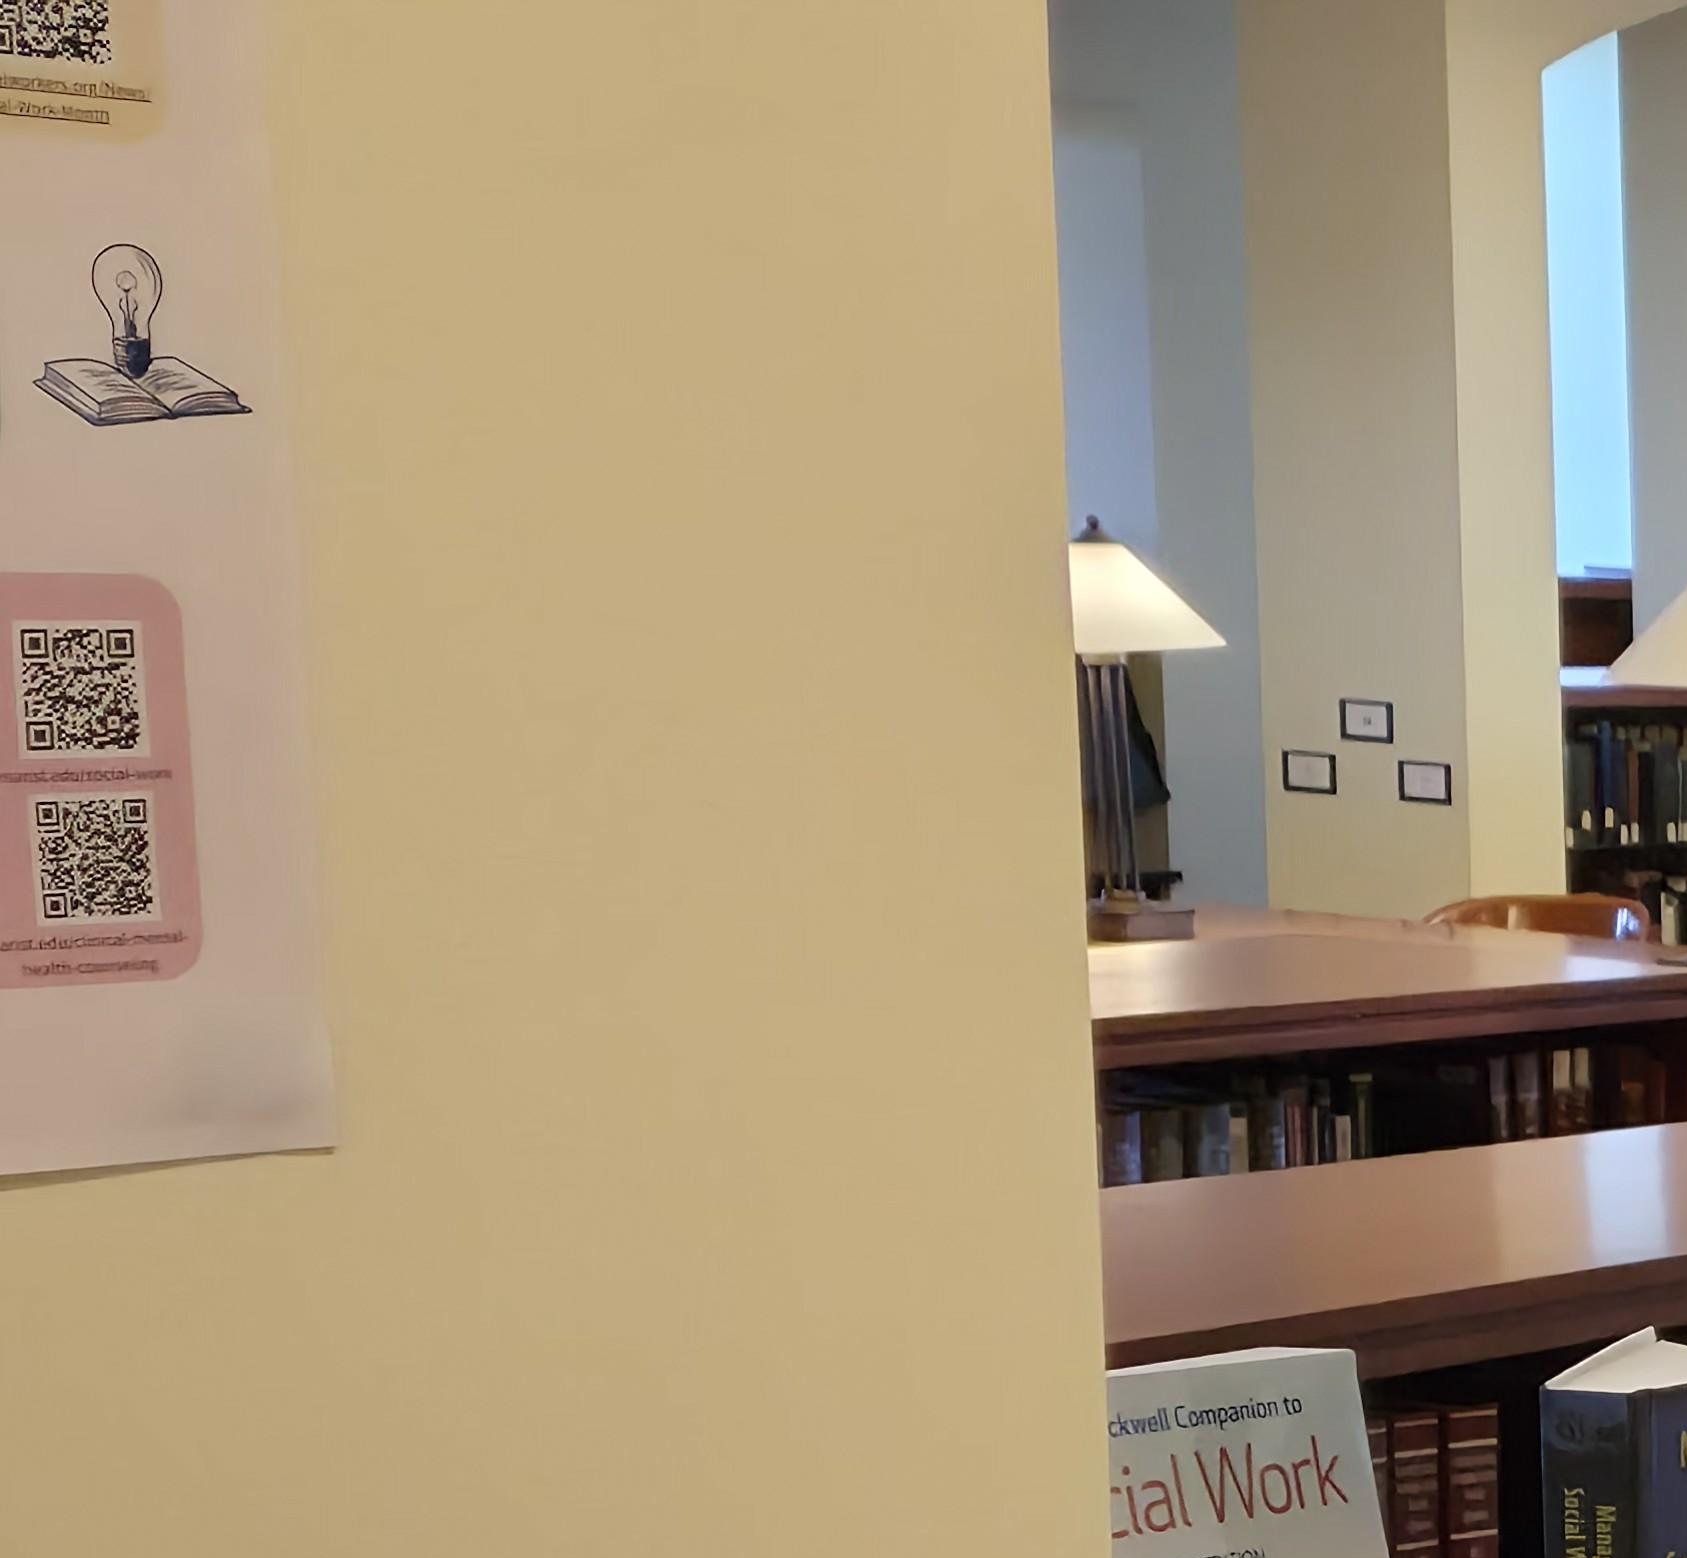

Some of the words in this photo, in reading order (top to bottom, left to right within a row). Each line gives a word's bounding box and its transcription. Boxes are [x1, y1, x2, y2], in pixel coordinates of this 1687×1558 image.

[1174, 1397, 1279, 1430] Companion
[1283, 1396, 1303, 1415] to
[1194, 1434, 1349, 1524] Work
[1564, 1487, 1586, 1539] Social
